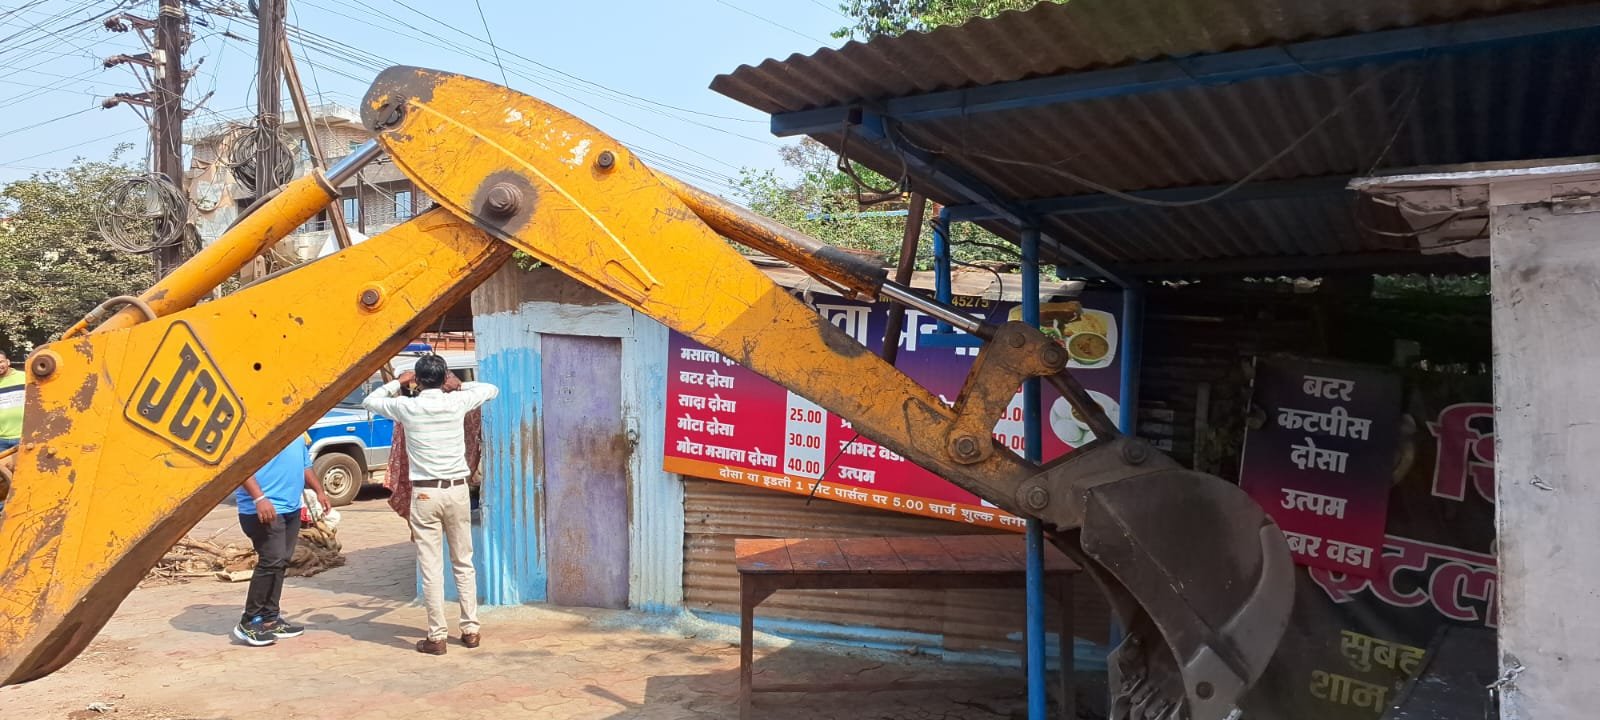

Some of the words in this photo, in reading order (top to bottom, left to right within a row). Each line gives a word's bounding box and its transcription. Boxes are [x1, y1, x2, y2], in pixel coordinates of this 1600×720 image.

[680, 347, 720, 363] मसाला
[680, 370, 704, 385] बटर
[706, 369, 735, 389] दोसा
[1302, 375, 1356, 402] बटर
[136, 341, 236, 456] JCB
[678, 394, 706, 410] सादा
[708, 393, 736, 413] दोसा
[677, 413, 704, 433] मोटा
[706, 417, 735, 437] दोसा
[790, 407, 822, 424] 25.00
[1277, 405, 1373, 441] कटपीस
[676, 436, 703, 455] मोटा
[705, 447, 745, 464] मसाला
[747, 447, 777, 468] दोसा
[788, 433, 821, 449] 30.00
[787, 458, 820, 475] 40.00
[1290, 436, 1349, 474] दोसा
[838, 465, 876, 484] उत्पम
[719, 466, 744, 481] दोसा
[747, 472, 759, 483] या
[796, 481, 803, 490] 1
[834, 486, 868, 502] पार्सल
[872, 494, 888, 505] पर
[893, 497, 924, 511] 5.00
[928, 502, 957, 516] चार्ज
[960, 508, 995, 523] शुल्क
[1280, 488, 1348, 520] उत्पम
[1282, 530, 1323, 558] बर
[1326, 539, 1374, 569] वडा
[1340, 629, 1426, 675] सुबह
